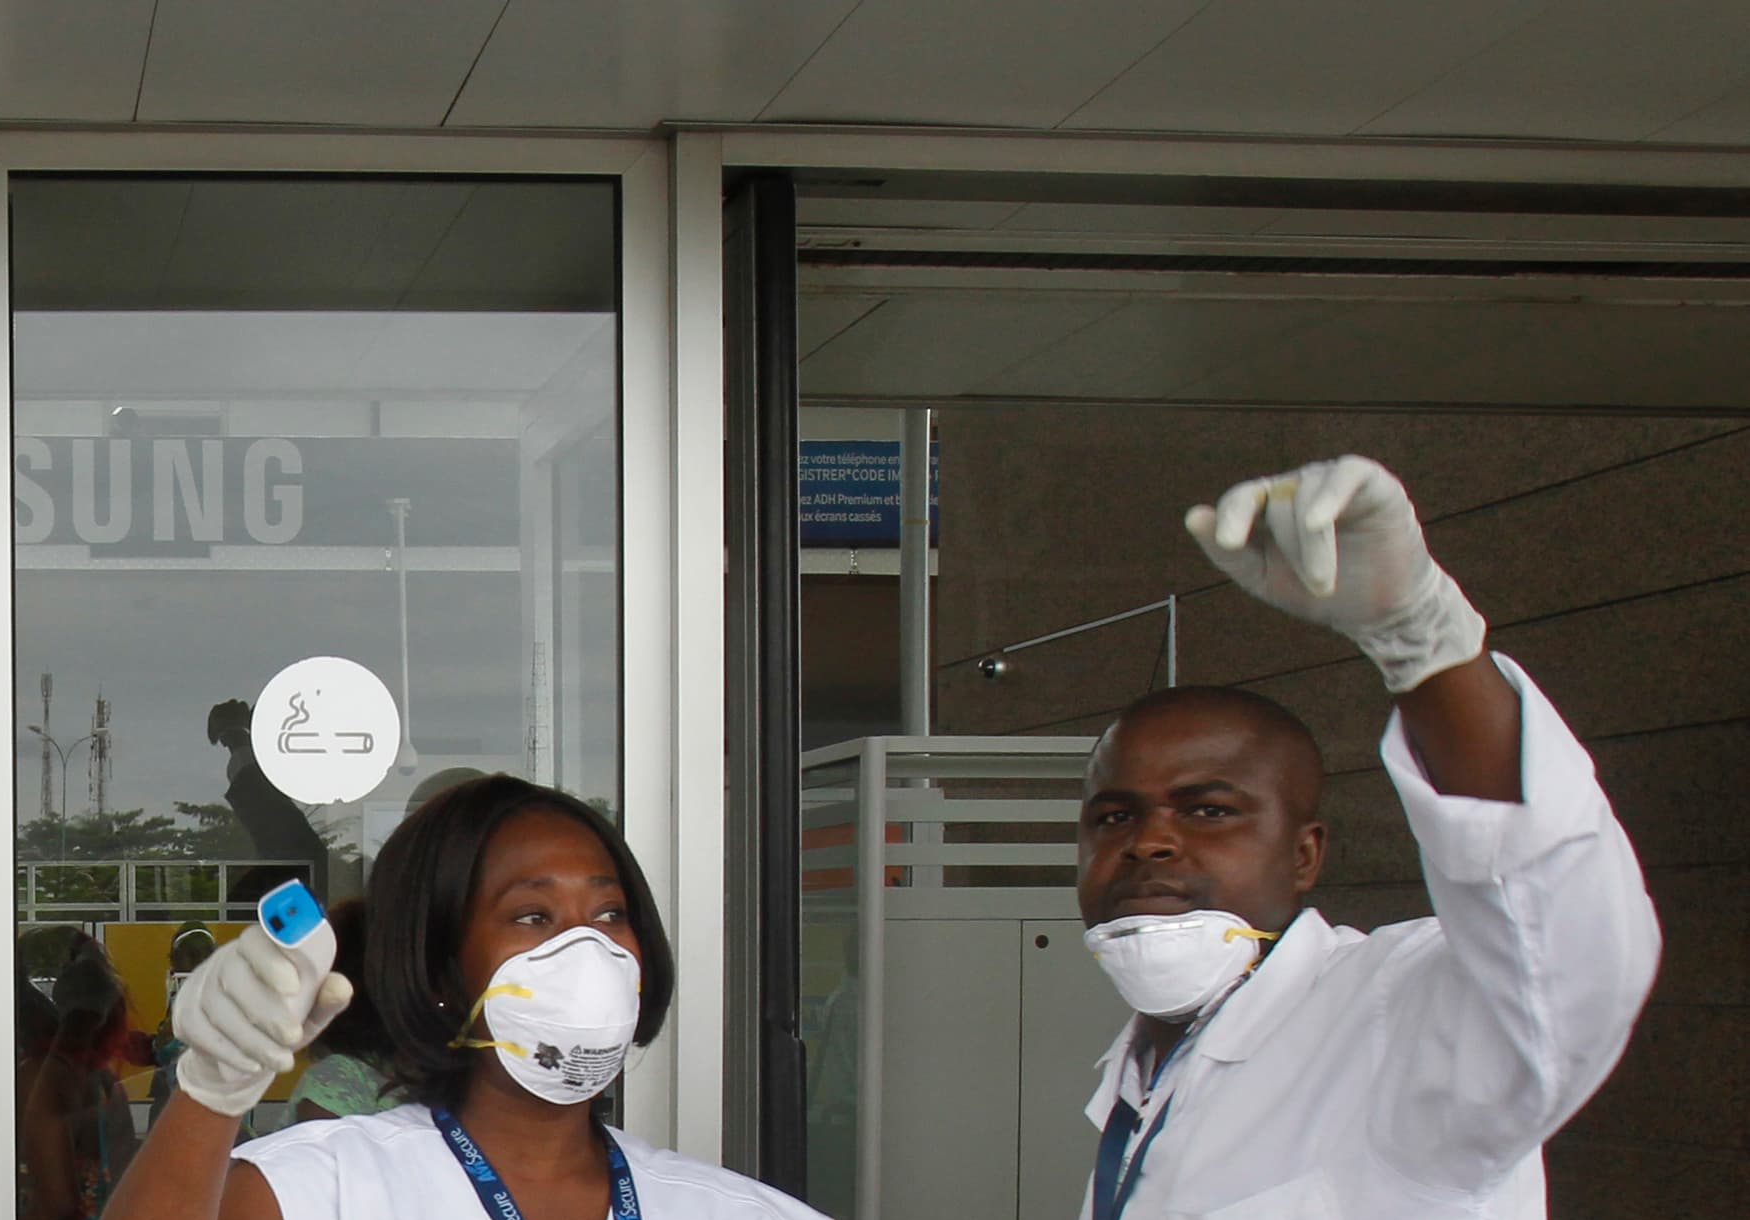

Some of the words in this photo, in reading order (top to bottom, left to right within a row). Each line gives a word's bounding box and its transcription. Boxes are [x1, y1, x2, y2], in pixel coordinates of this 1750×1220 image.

[811, 455, 835, 465] votre
[837, 451, 886, 468] téléphone
[813, 493, 836, 505] ADH
[838, 492, 883, 505] Premium
[815, 509, 848, 522] écrans
[849, 510, 883, 522] cassés
